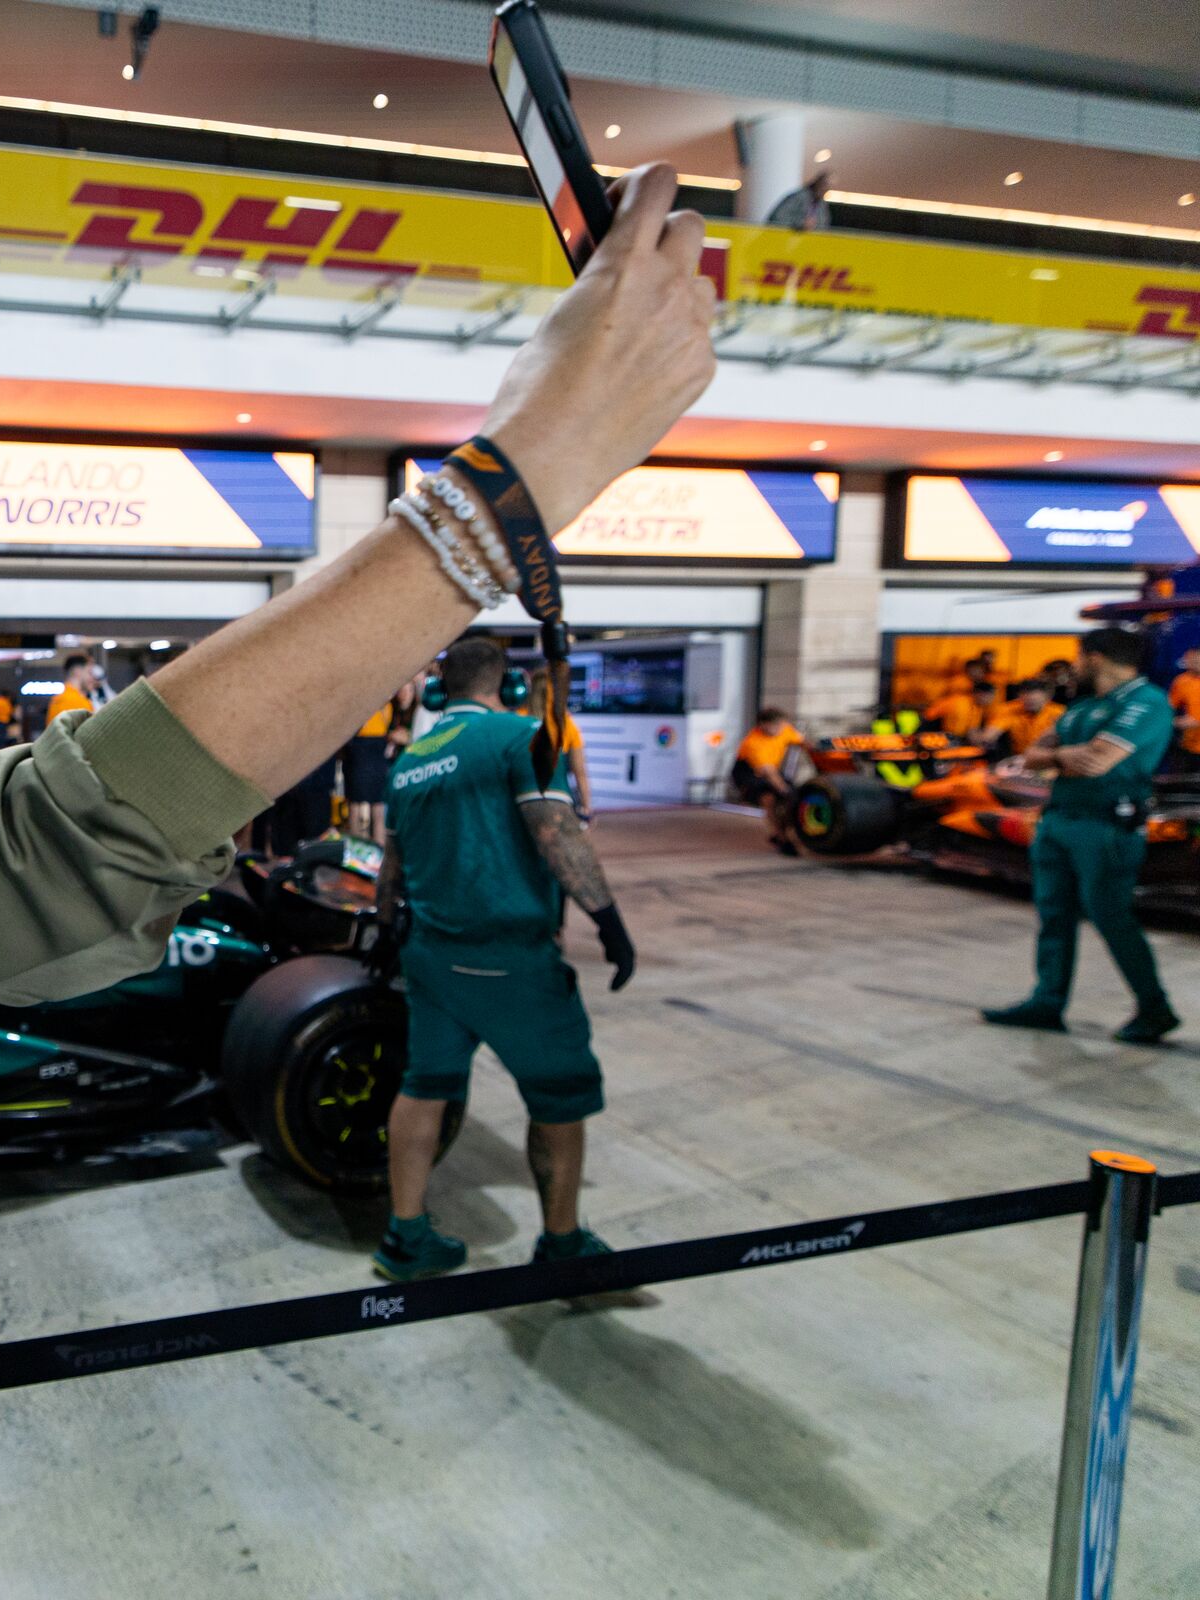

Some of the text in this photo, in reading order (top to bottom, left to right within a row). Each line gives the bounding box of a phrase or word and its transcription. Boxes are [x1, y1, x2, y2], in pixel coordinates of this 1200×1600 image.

[64, 179, 419, 281] DHL
[759, 260, 855, 293] DHL
[604, 479, 698, 512] SCAR
[393, 755, 459, 789] aramco
[740, 1232, 851, 1264] McLaren
[361, 1295, 405, 1319] flex
